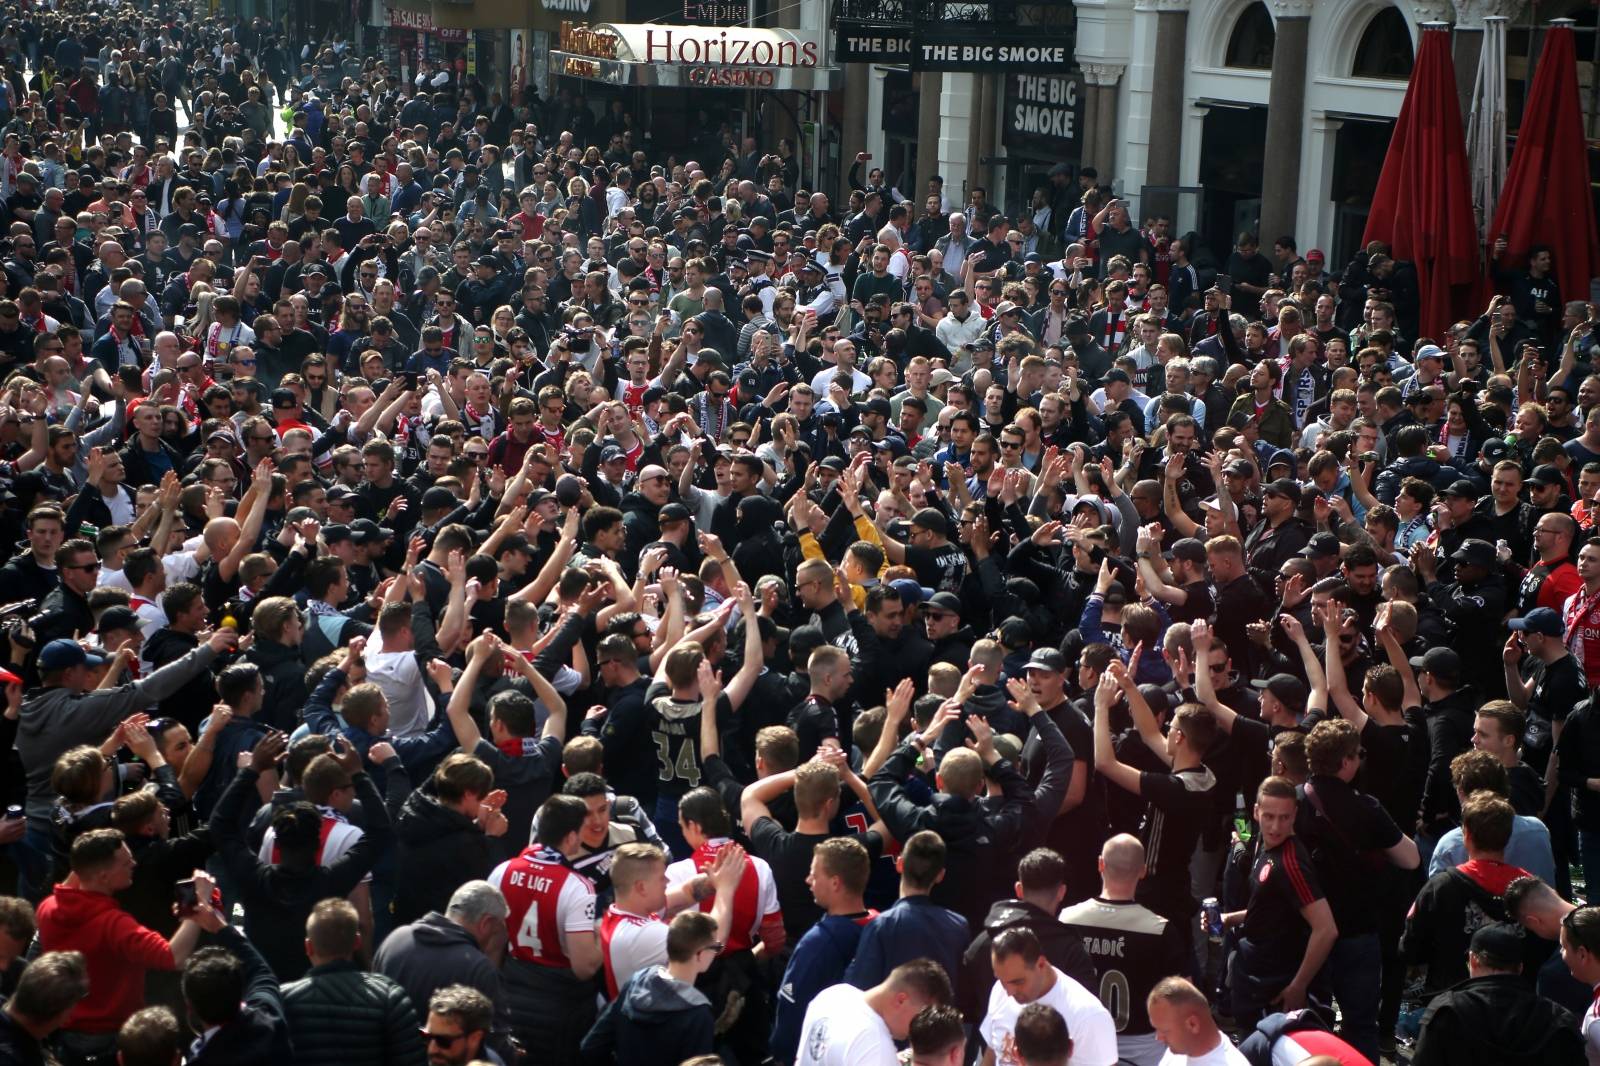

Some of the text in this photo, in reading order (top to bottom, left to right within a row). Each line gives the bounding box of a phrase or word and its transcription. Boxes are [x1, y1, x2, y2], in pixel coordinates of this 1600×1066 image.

[401, 10, 422, 28] SALE
[441, 29, 462, 38] OFF
[847, 37, 882, 53] THE
[646, 30, 818, 67] Horizons
[922, 45, 1065, 63] THE BIG SMOKE
[689, 66, 774, 87] CASINO
[1017, 74, 1077, 106] THE BIG
[1014, 104, 1075, 138] SMOKE
[651, 730, 702, 787] 34
[510, 870, 553, 894] DE LIGT
[516, 900, 544, 957] 4
[1082, 936, 1126, 958] TADIĆ
